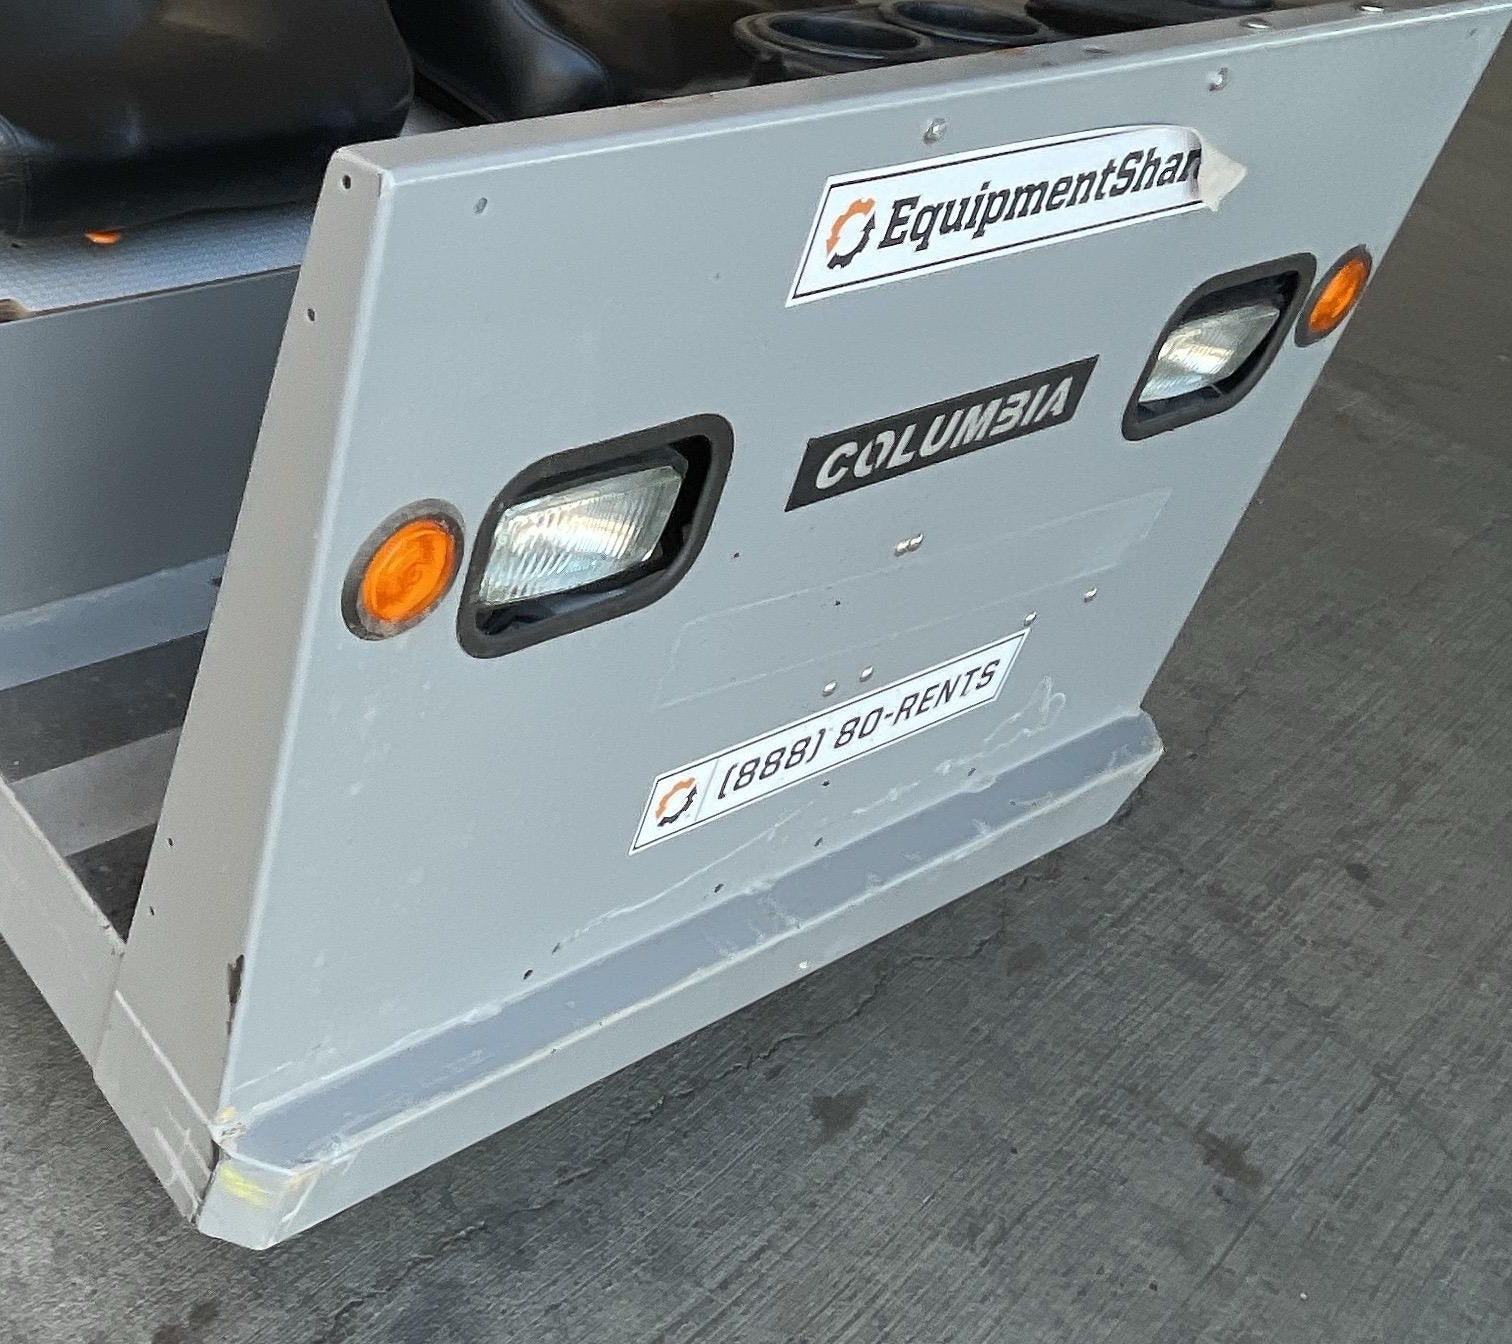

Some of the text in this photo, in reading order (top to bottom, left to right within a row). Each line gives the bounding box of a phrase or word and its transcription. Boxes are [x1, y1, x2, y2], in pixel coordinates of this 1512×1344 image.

[815, 376, 1074, 492] COLUMBIA
[717, 658, 1001, 801] (888) 80-RENTS
